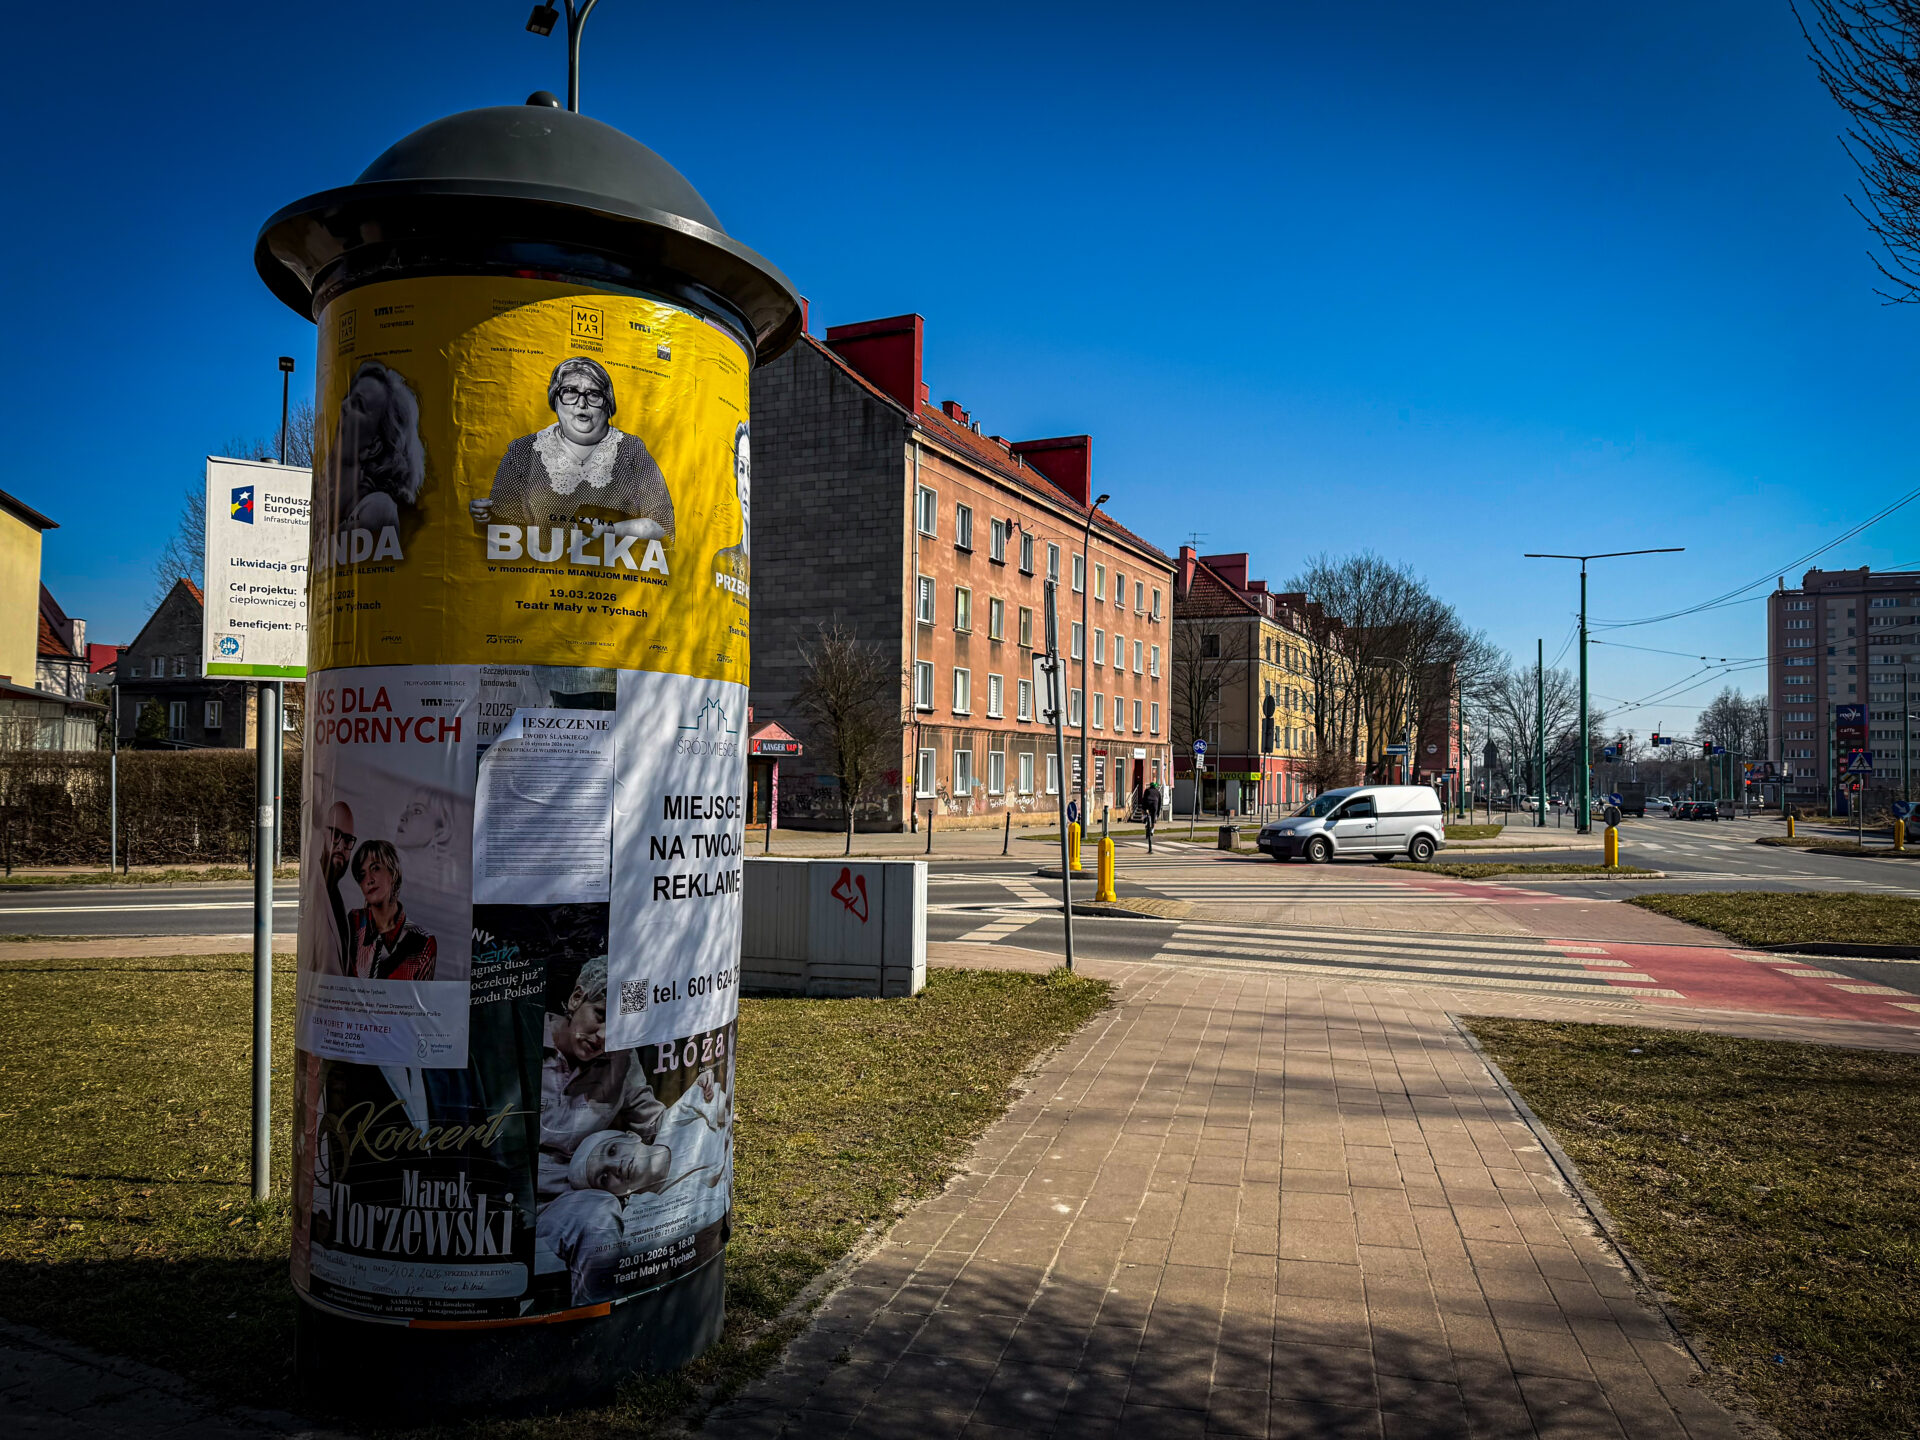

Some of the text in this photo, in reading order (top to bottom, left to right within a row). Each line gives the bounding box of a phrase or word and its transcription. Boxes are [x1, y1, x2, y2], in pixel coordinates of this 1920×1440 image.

[264, 503, 311, 517] Europejs
[264, 515, 309, 526] Infrastruktur
[487, 524, 670, 576] BUŁKA
[230, 557, 287, 572] Likwidacja
[500, 565, 565, 576] monodramie
[567, 567, 621, 581] MIANUJOM
[622, 573, 639, 583] MIE
[640, 576, 668, 588] HANKA
[229, 582, 297, 596] Cel projektu:
[550, 588, 617, 602] 19.03.2026
[229, 594, 297, 609] ciepłowniczej
[516, 600, 550, 611] Teatr
[553, 602, 583, 614] Mały
[602, 606, 649, 618] Tychach
[229, 618, 292, 632] Beneficjent:
[317, 686, 392, 716] KS DLA
[315, 716, 462, 746] OPORNYCH
[522, 717, 610, 731] IESZCZENIE
[663, 795, 741, 820] MIEJSCE
[650, 835, 686, 861] NA
[471, 973, 519, 991] oczekuję
[653, 968, 733, 1004] tel. 601 624
[345, 1032, 361, 1041] 2026
[347, 1022, 353, 1030] W
[355, 1023, 392, 1034] TEATRZE!
[653, 1031, 725, 1074] Róża
[337, 1100, 537, 1162] Koncert
[401, 1169, 472, 1209] Marek
[332, 1181, 514, 1257] Torzewski
[613, 1247, 697, 1284] Teatr Mały w Tychach
[618, 1248, 669, 1269] 20.01.2026
